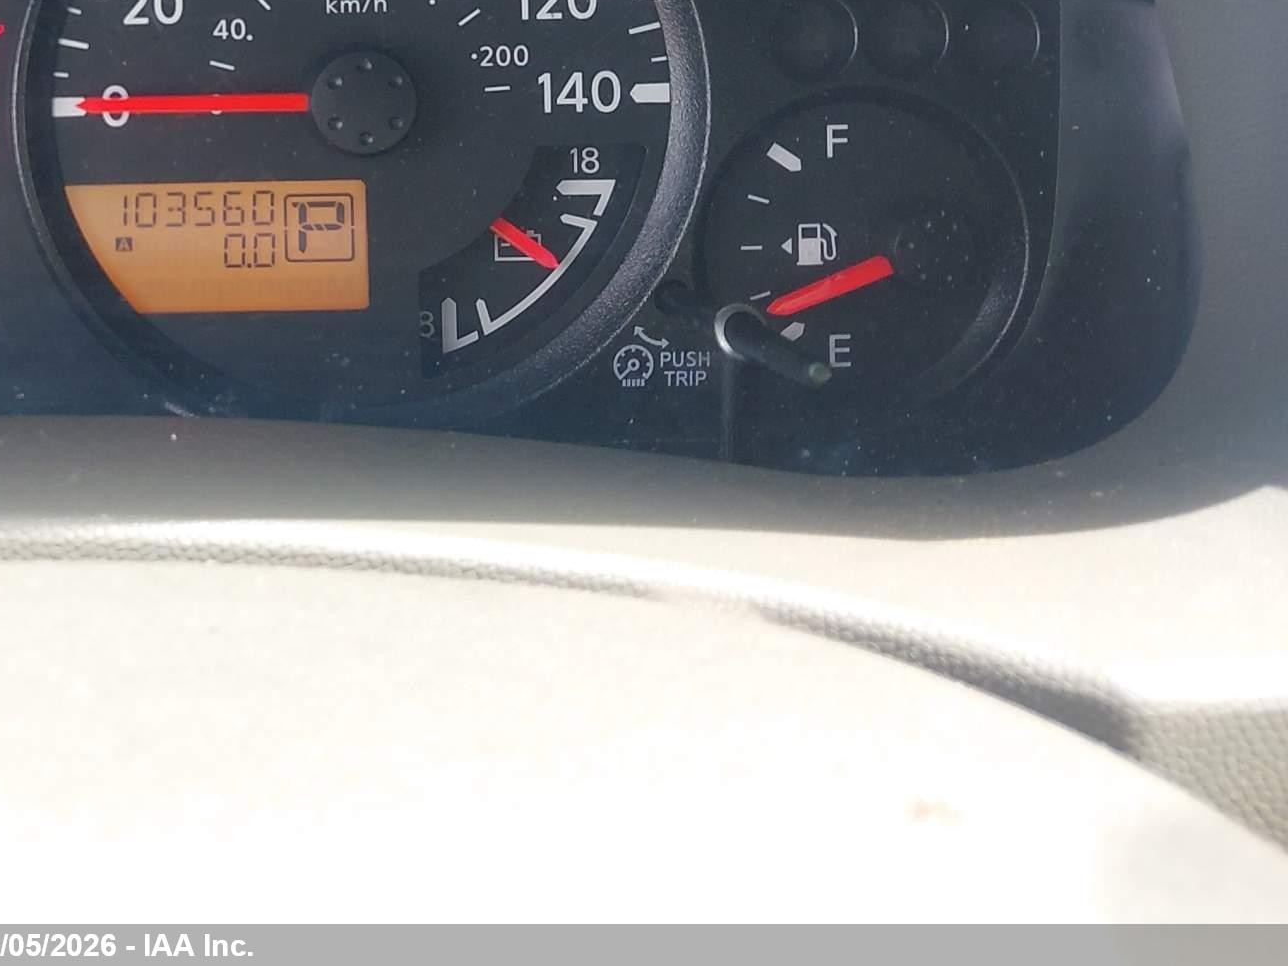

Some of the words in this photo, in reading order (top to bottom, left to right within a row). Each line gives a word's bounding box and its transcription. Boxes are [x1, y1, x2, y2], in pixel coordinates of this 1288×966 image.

[213, 19, 245, 39] 40
[480, 46, 528, 66] 200
[103, 85, 129, 127] 0
[538, 71, 620, 113] 140
[827, 124, 849, 158] F
[571, 148, 599, 173] 18
[123, 191, 276, 228] 103560
[292, 200, 346, 254] P
[224, 233, 276, 268] 0.0
[661, 351, 710, 367] PUSH
[829, 334, 851, 368] E
[664, 370, 708, 387] TRIP
